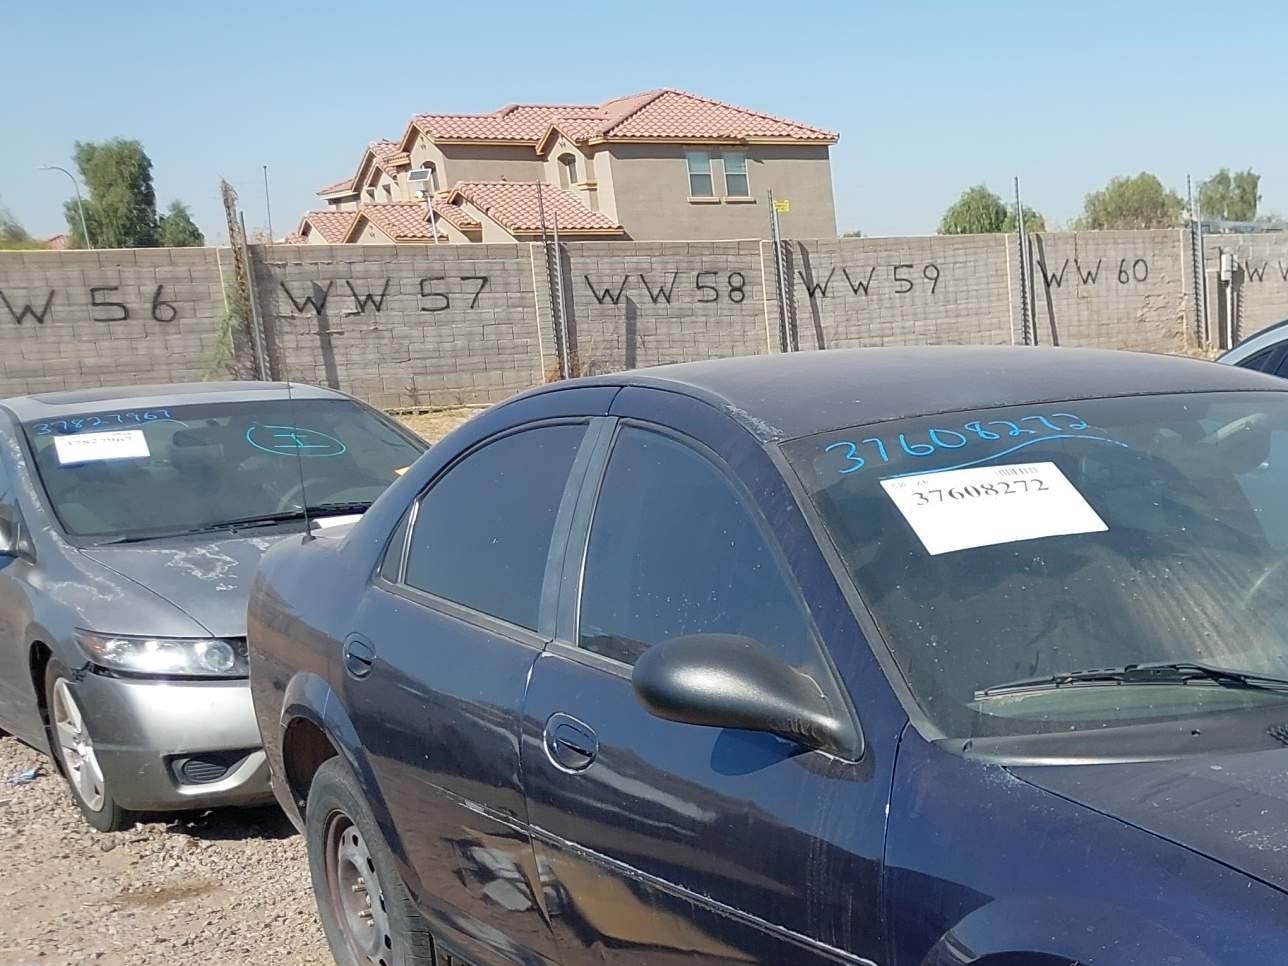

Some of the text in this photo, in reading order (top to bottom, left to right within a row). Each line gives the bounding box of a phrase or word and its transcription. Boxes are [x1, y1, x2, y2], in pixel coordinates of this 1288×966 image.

[696, 271, 746, 303] 58
[893, 264, 940, 295] 59
[1117, 258, 1149, 284] 60
[90, 284, 176, 323] 56
[419, 276, 488, 312] 57
[825, 412, 1098, 474] 37608272
[911, 478, 1050, 507] 37608272
